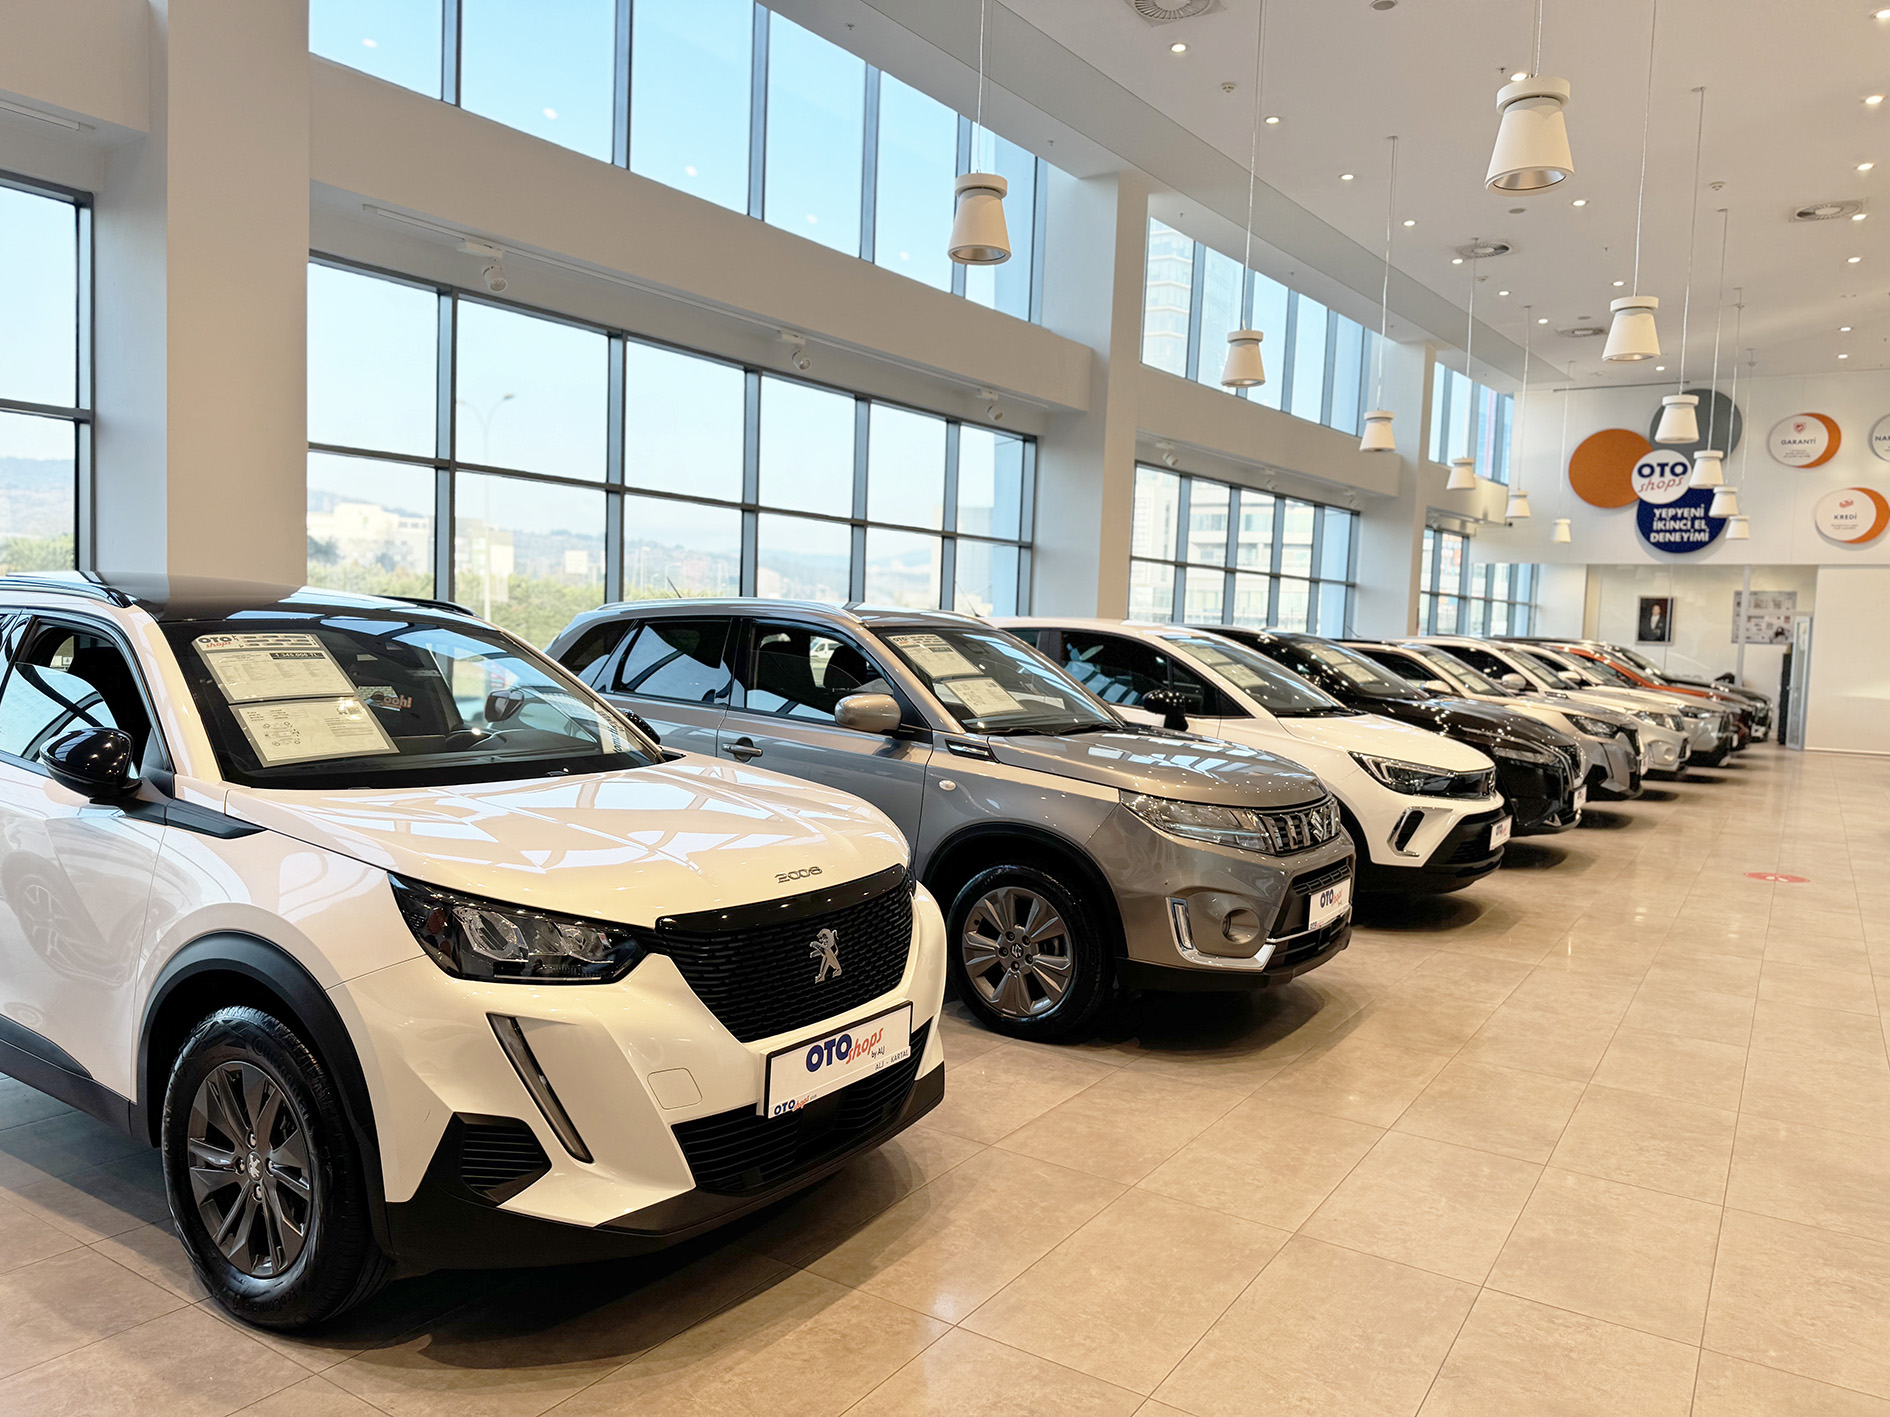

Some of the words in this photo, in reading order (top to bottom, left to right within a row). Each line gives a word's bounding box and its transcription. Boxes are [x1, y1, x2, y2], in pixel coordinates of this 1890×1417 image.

[1780, 437, 1817, 446] GARANTİ
[1637, 461, 1688, 478] OTO
[1638, 476, 1684, 493] shops
[1653, 504, 1705, 519] YEPYENİ
[1833, 512, 1858, 520] KREDİ
[1653, 517, 1691, 531] İKİNCİ
[1694, 519, 1708, 530] EL
[1650, 529, 1709, 543] DENEYİMİ
[198, 636, 233, 644] OTO
[206, 640, 233, 649] shops
[774, 866, 823, 884] 2008
[871, 1050, 878, 1060] by
[890, 1050, 909, 1063] KARTAL
